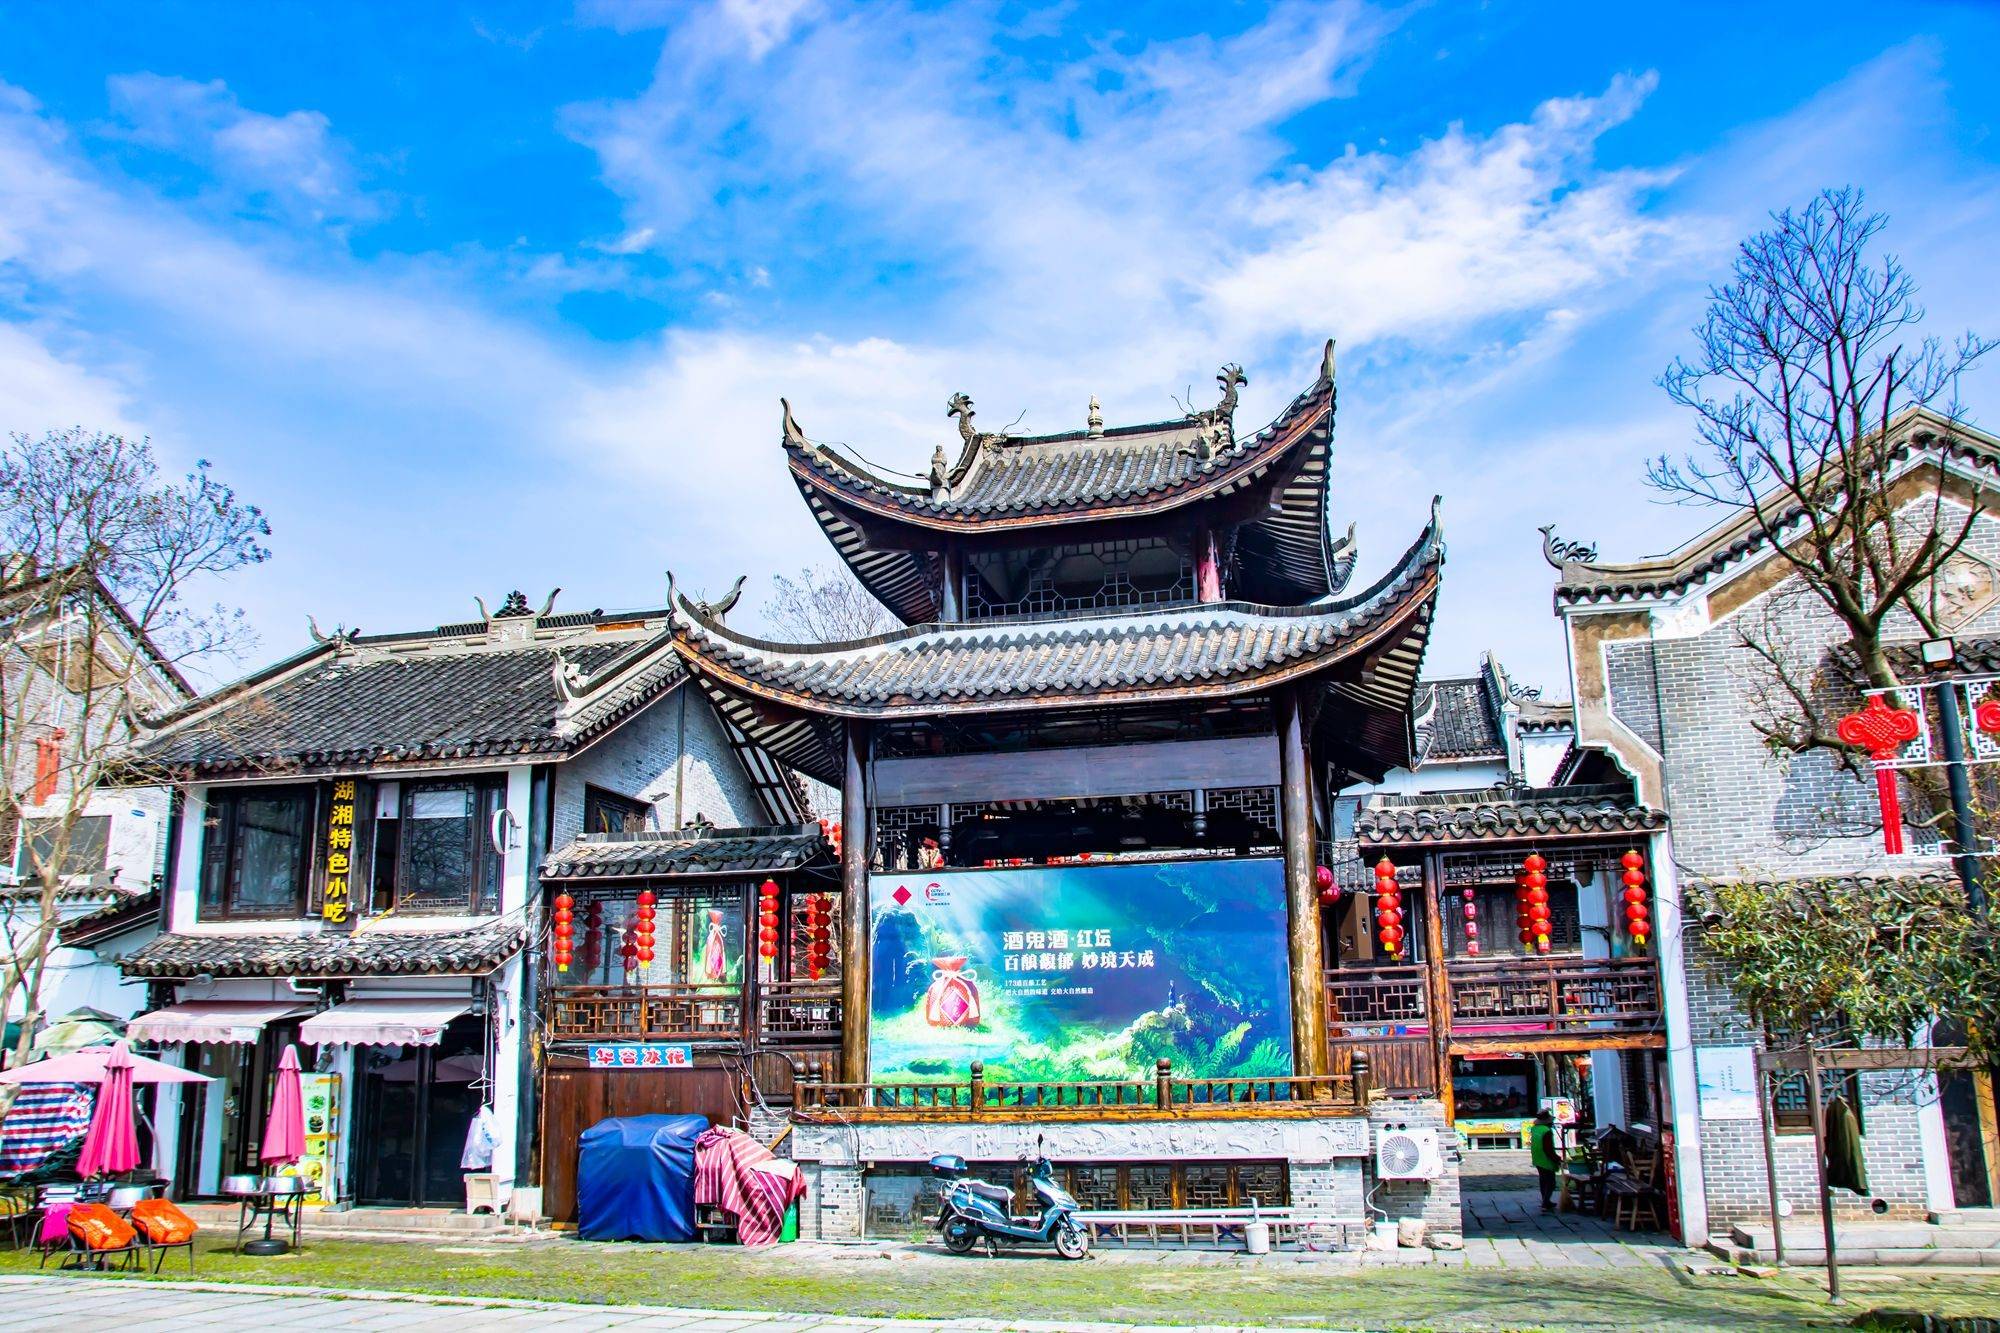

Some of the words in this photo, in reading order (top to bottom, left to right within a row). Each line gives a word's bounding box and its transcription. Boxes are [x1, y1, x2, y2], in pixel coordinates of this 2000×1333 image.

[323, 781, 354, 922] 湖湘特色小吃
[1003, 929, 1111, 950] 酒鬼酒·红坛
[1082, 950, 1155, 969] 妙境天成
[596, 1047, 686, 1065] 华容冰花
